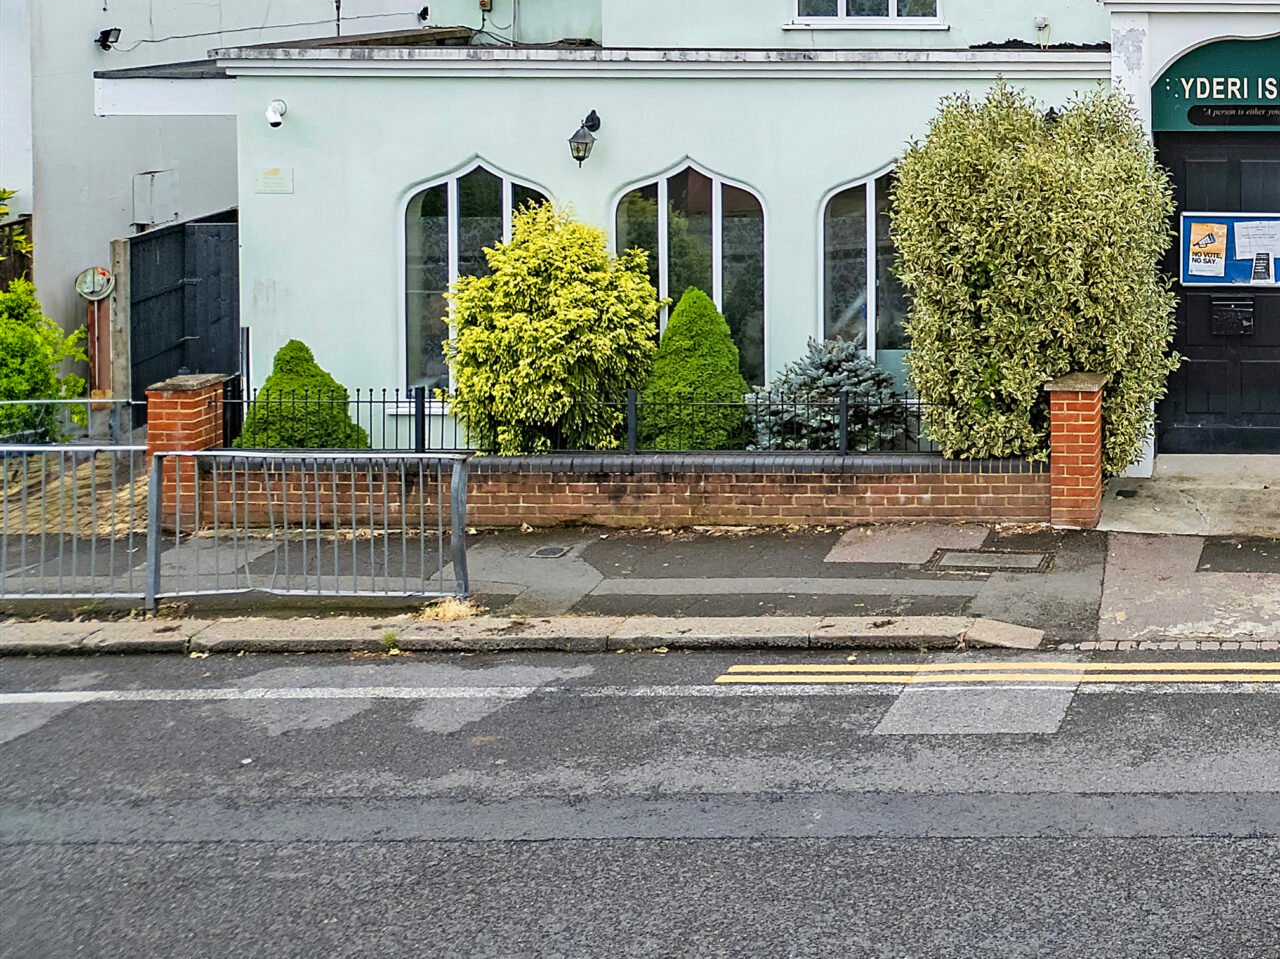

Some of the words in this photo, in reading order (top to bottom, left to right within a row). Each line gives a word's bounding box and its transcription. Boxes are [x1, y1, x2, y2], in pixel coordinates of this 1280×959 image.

[1213, 109, 1236, 117] person
[1246, 107, 1266, 115] either
[1203, 252, 1223, 260] VOTE,
